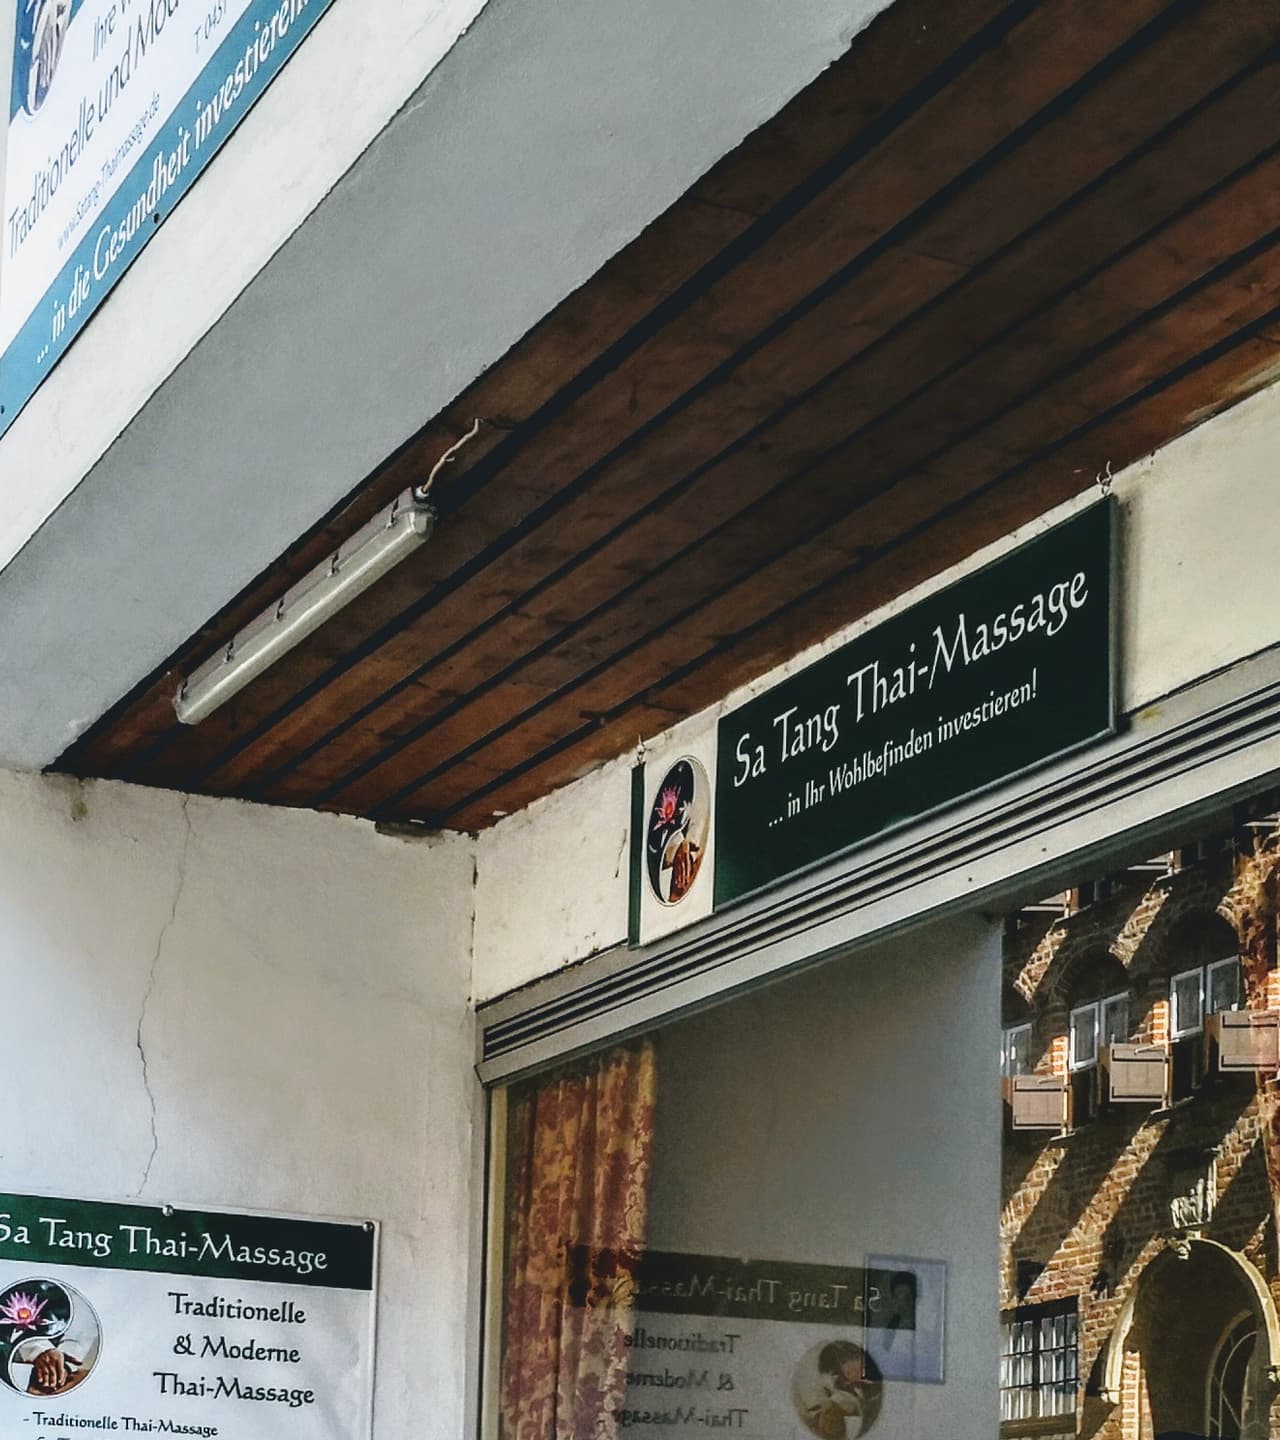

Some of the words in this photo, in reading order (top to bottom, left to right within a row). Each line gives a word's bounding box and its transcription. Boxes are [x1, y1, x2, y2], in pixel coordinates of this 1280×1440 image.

[93, 4, 117, 61] Ihre
[7, 106, 95, 259] Traditionelle
[97, 25, 132, 125] und
[51, 300, 66, 342] in
[68, 264, 90, 320] die
[93, 126, 192, 281] Gesundheit
[733, 732, 766, 788] Sa
[773, 703, 840, 764] Tang
[846, 571, 1089, 724] Thai-Massage
[787, 792, 801, 818] in
[804, 779, 825, 810] Ihr
[827, 730, 934, 796] Wohlbefinden
[936, 667, 1038, 746] investieren!
[39, 1217, 113, 1257] Tang
[119, 1223, 329, 1273] Thai-Massage
[168, 1292, 307, 1324] Traditionelle
[173, 1333, 197, 1356] &
[200, 1335, 302, 1363] Moderne
[153, 1371, 315, 1407] Thai-Massage
[32, 1411, 119, 1430] Traditionelle
[120, 1416, 219, 1438] Thai-Massage
